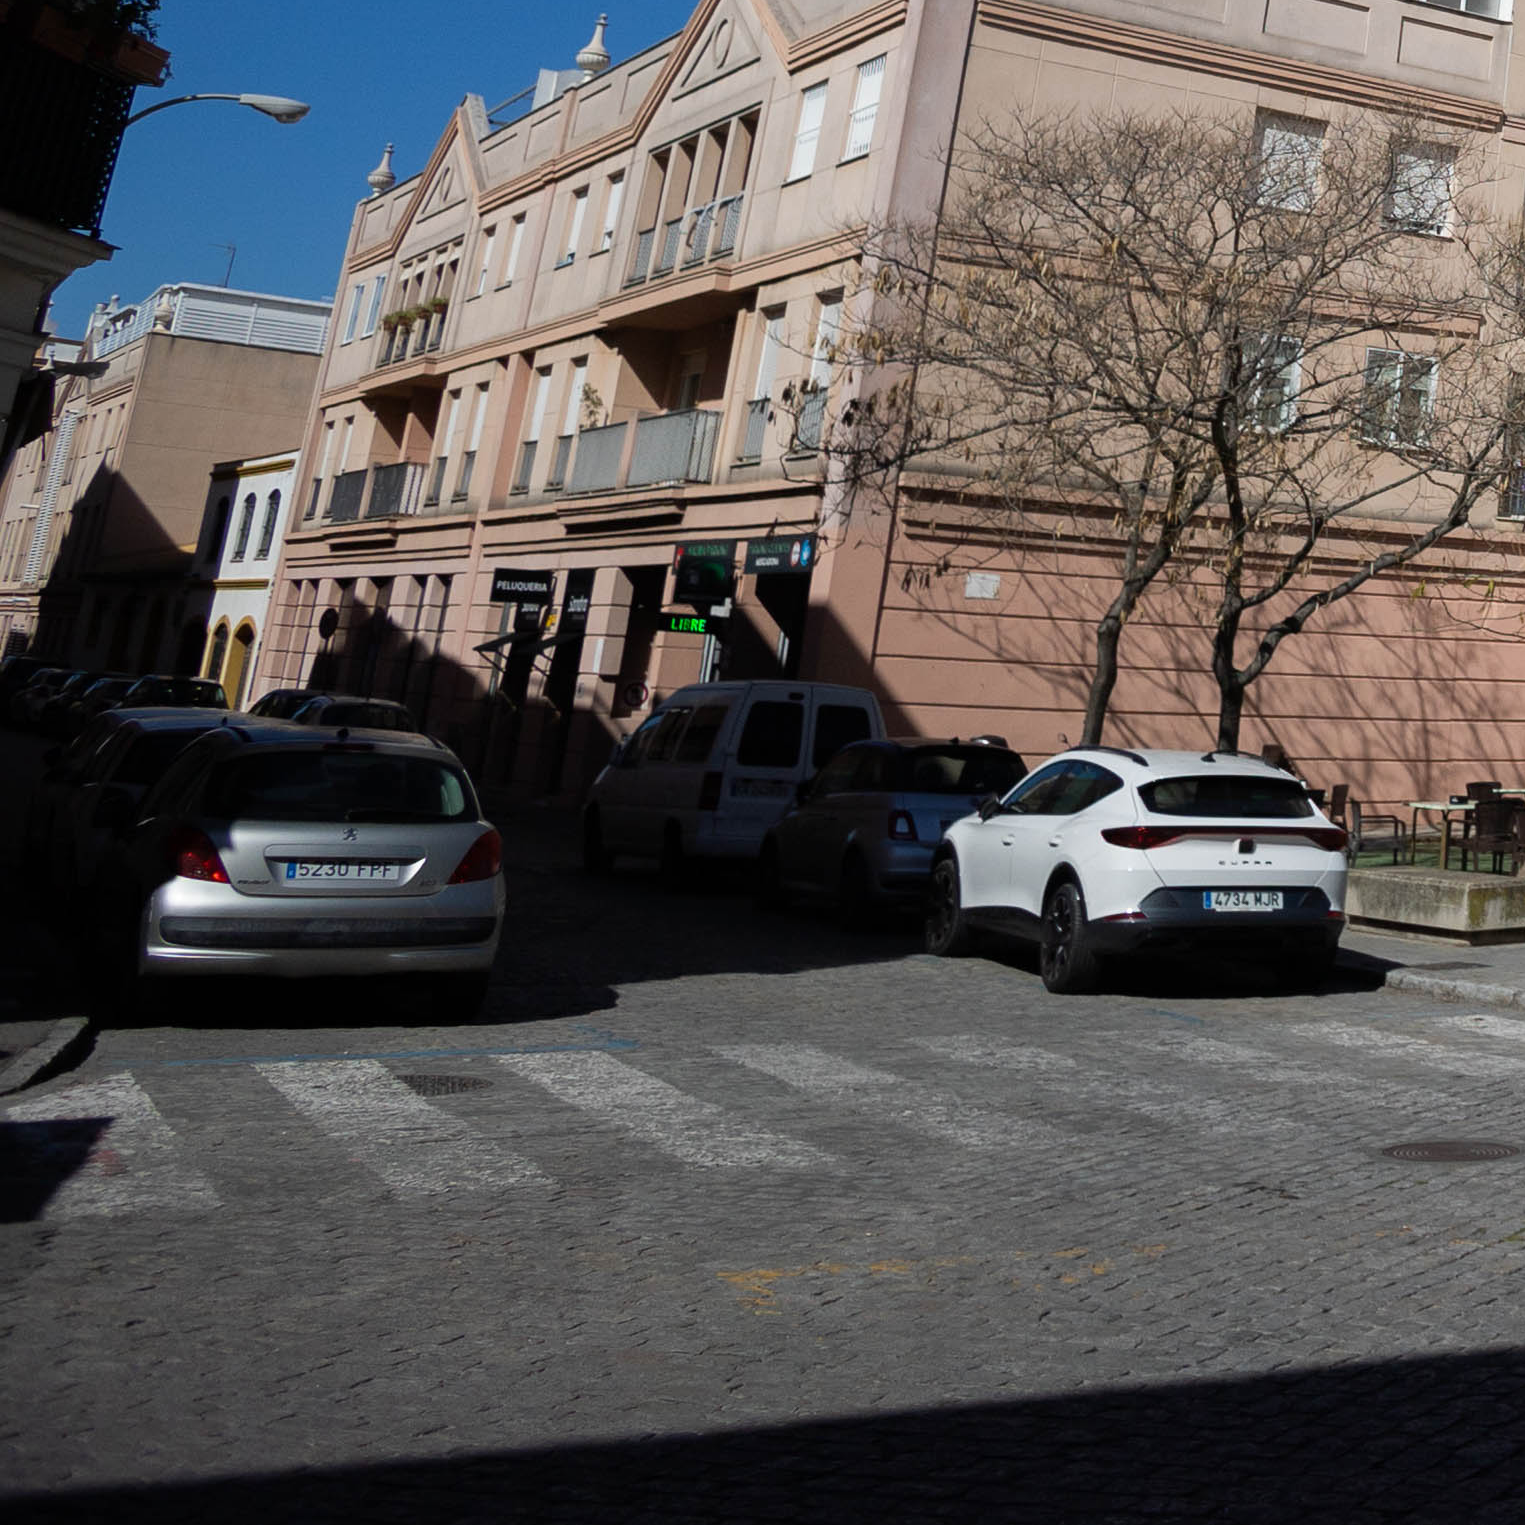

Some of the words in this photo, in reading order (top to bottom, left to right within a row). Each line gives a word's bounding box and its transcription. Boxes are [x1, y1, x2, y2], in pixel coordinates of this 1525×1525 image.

[671, 618, 707, 632] LIBRE
[299, 862, 349, 877] 5230
[357, 862, 392, 877] FPF
[1214, 892, 1249, 906] 4734
